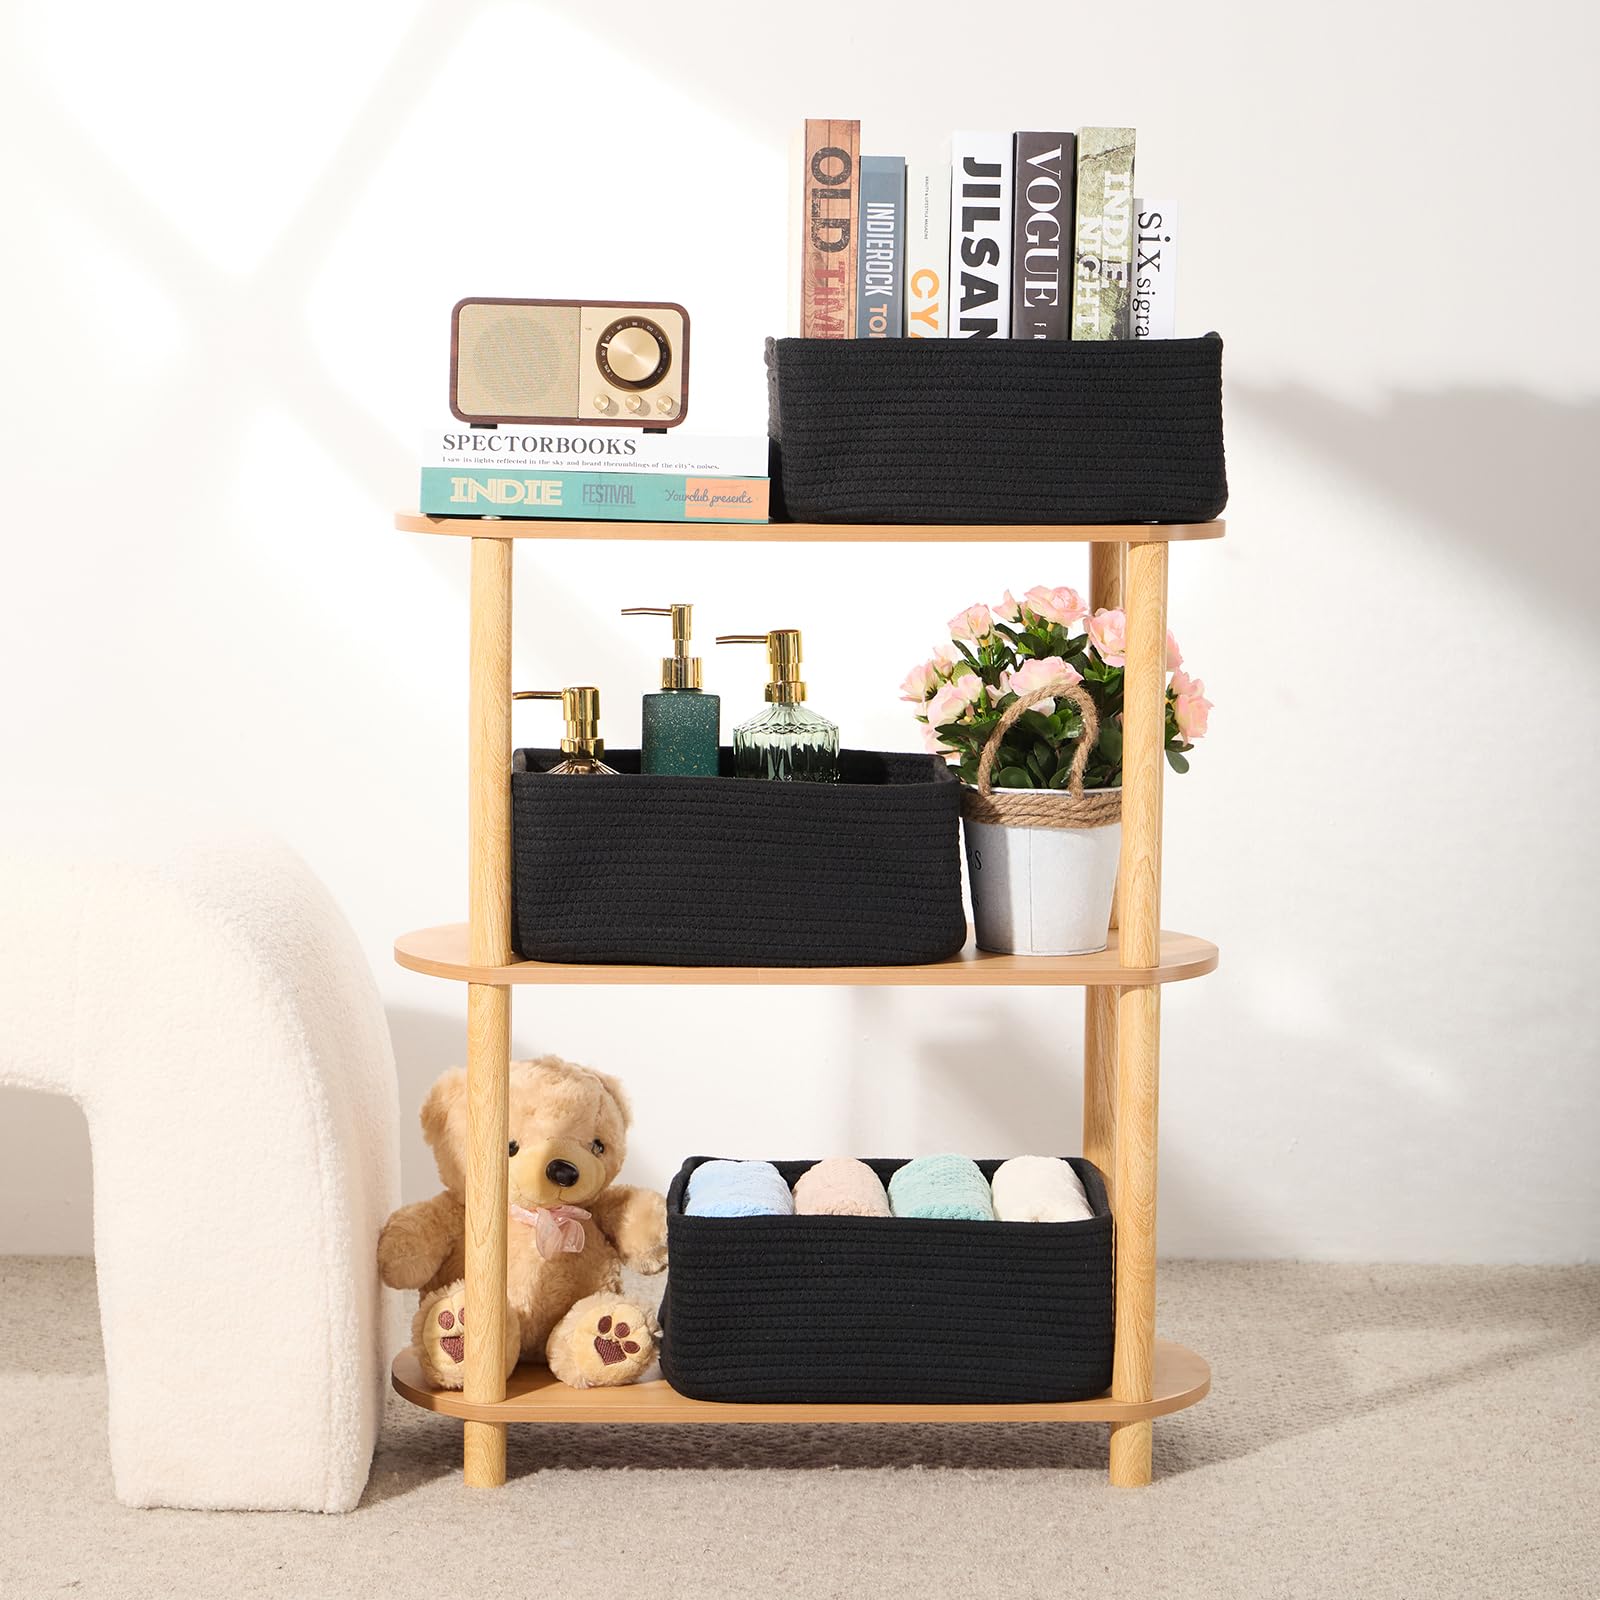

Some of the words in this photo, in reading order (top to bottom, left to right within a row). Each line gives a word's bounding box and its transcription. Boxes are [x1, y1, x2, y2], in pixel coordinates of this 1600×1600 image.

[811, 146, 852, 254] OLD
[1023, 143, 1063, 308] VOGUE
[1101, 170, 1131, 289] INDIE
[864, 201, 895, 297] INDIEROCK
[1076, 214, 1102, 332] NIGHT
[868, 303, 888, 339] TO
[910, 268, 940, 339] CY
[442, 433, 637, 456] SPECTORBOOKS
[496, 457, 527, 465] reflected
[552, 459, 564, 467] sky
[450, 476, 564, 506] INDIE
[582, 483, 636, 505] FESTIVAL
[709, 490, 754, 507] presents
